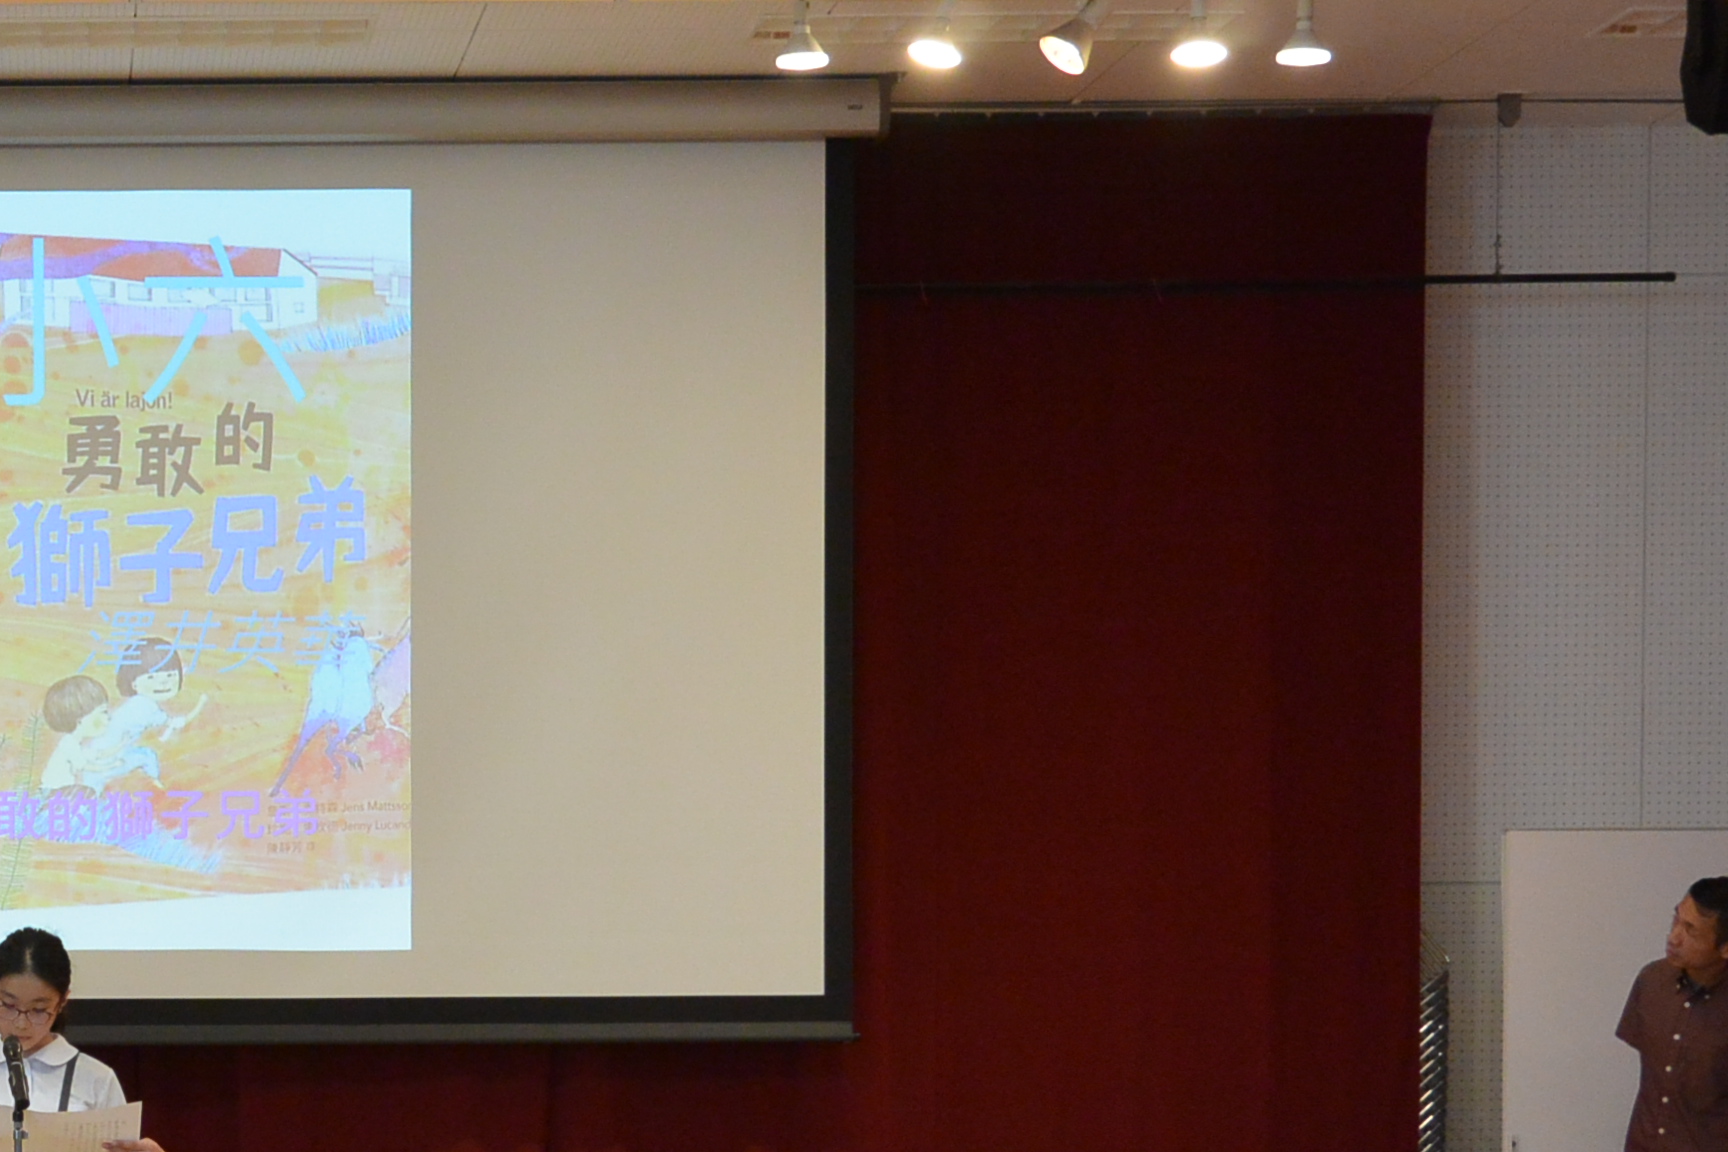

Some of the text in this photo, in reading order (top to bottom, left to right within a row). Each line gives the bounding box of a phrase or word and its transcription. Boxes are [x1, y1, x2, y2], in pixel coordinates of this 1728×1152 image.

[75, 389, 95, 408] Vi
[100, 391, 120, 408] är
[62, 401, 273, 497] 勇敢的
[7, 474, 367, 609] 獅子兄弟
[77, 609, 367, 674] 澤井英華
